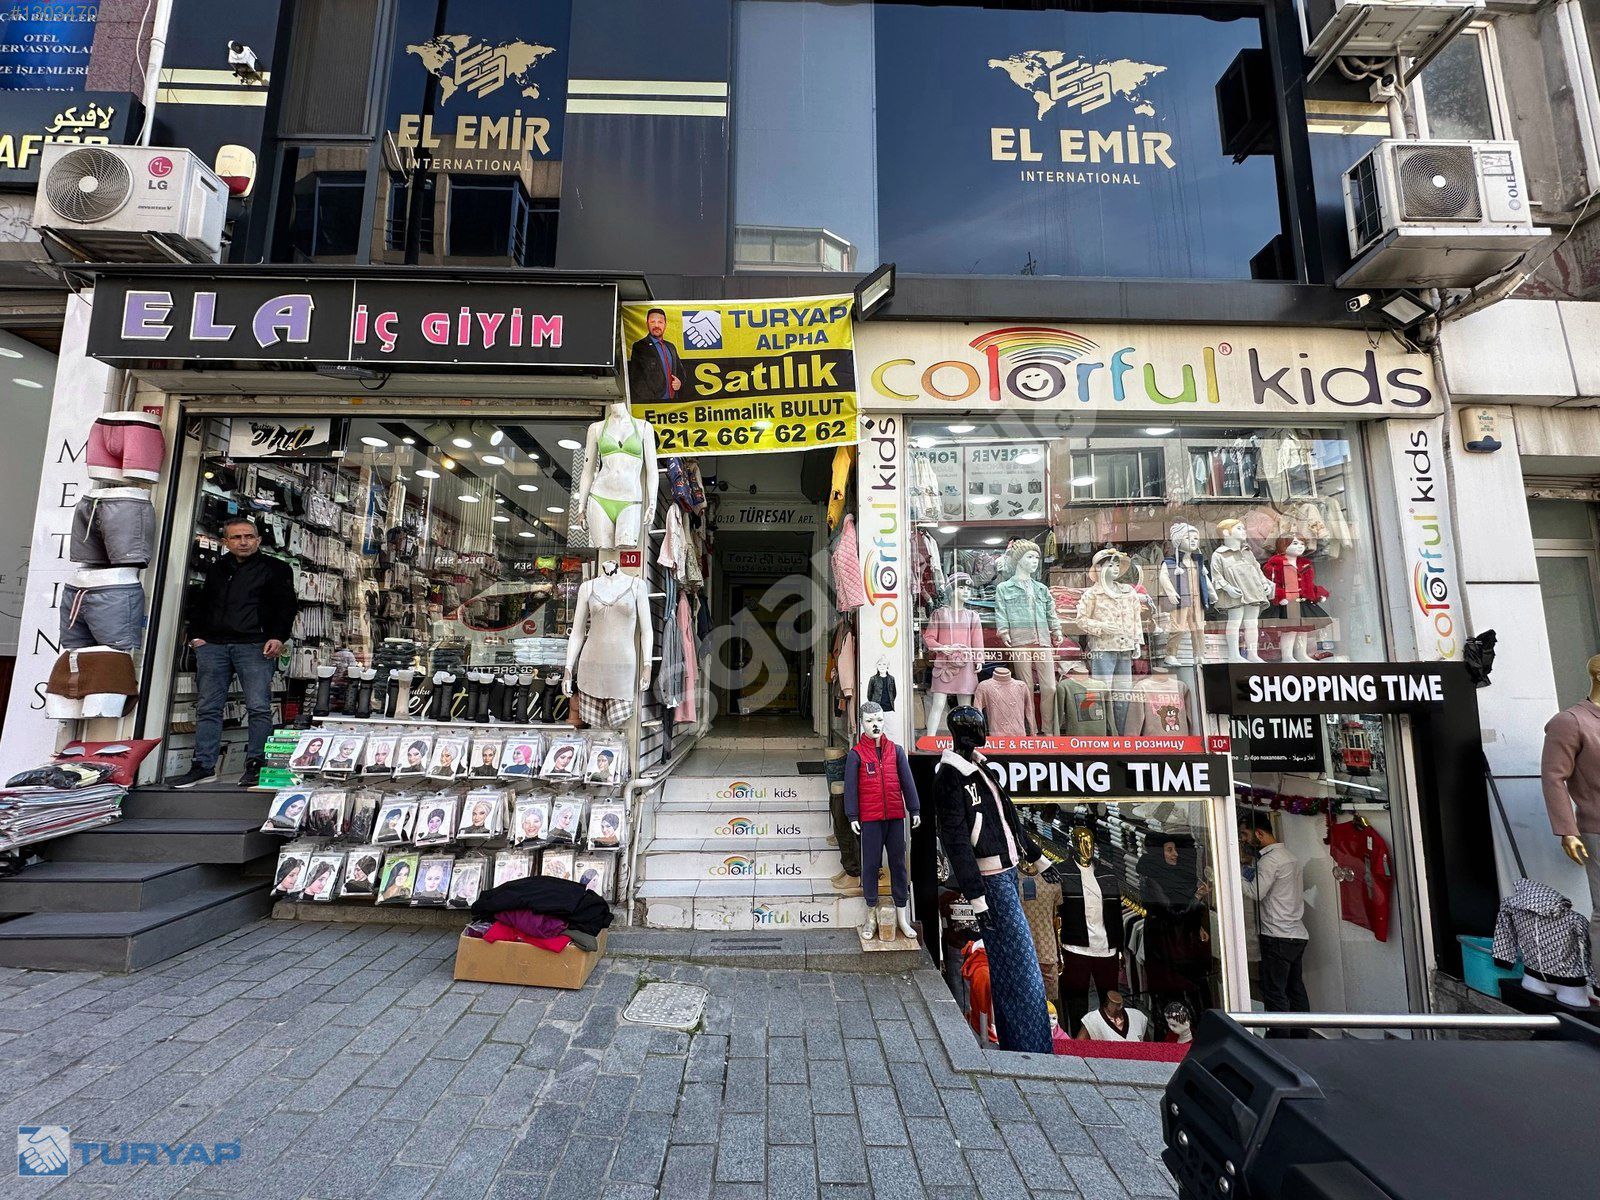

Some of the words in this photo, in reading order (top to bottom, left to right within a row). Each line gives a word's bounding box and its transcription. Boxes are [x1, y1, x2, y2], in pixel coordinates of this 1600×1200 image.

[23, 34, 60, 42] OTEL
[44, 102, 114, 133] لافيكو
[400, 114, 440, 148] EL
[456, 109, 550, 155] EMİR
[991, 128, 1043, 161] EL
[1060, 125, 1176, 169] EMİR
[405, 158, 531, 172] INTERNATIONAL
[148, 180, 168, 190] LG
[1021, 171, 1141, 185] INTERNATIONAL
[121, 290, 315, 348] ELA
[354, 304, 398, 353] İÇ
[421, 305, 563, 349] GİYİM
[728, 306, 847, 329] TURYAP
[756, 330, 829, 350] ALPHA
[694, 354, 838, 396] Satılık
[870, 345, 1221, 405] colorful
[1248, 347, 1432, 408] kids
[644, 410, 688, 425] Enes
[695, 404, 775, 423] Binmalik
[781, 399, 844, 418] BULUT
[717, 426, 765, 446] 667
[775, 423, 806, 443] 62
[816, 420, 846, 440] 62
[871, 417, 896, 490] kids
[1404, 430, 1435, 502] kids
[739, 506, 796, 523] TÜRESAY
[797, 515, 814, 524] APT.
[625, 554, 637, 564] 10
[871, 502, 898, 648] colorful
[1413, 515, 1456, 659] colorful
[1248, 674, 1377, 703] SHOPPING
[1381, 674, 1444, 702] TIME
[1268, 718, 1314, 739] TIME
[1020, 739, 1058, 750] RETAIL
[1070, 737, 1111, 749] Оптом
[1113, 740, 1121, 749] и
[1124, 740, 1132, 749] в
[1135, 739, 1185, 751] розницу
[1127, 761, 1211, 793] TIME
[773, 787, 797, 799] kids
[776, 823, 801, 836] kids
[775, 863, 802, 877] kids
[800, 910, 829, 924] kids
